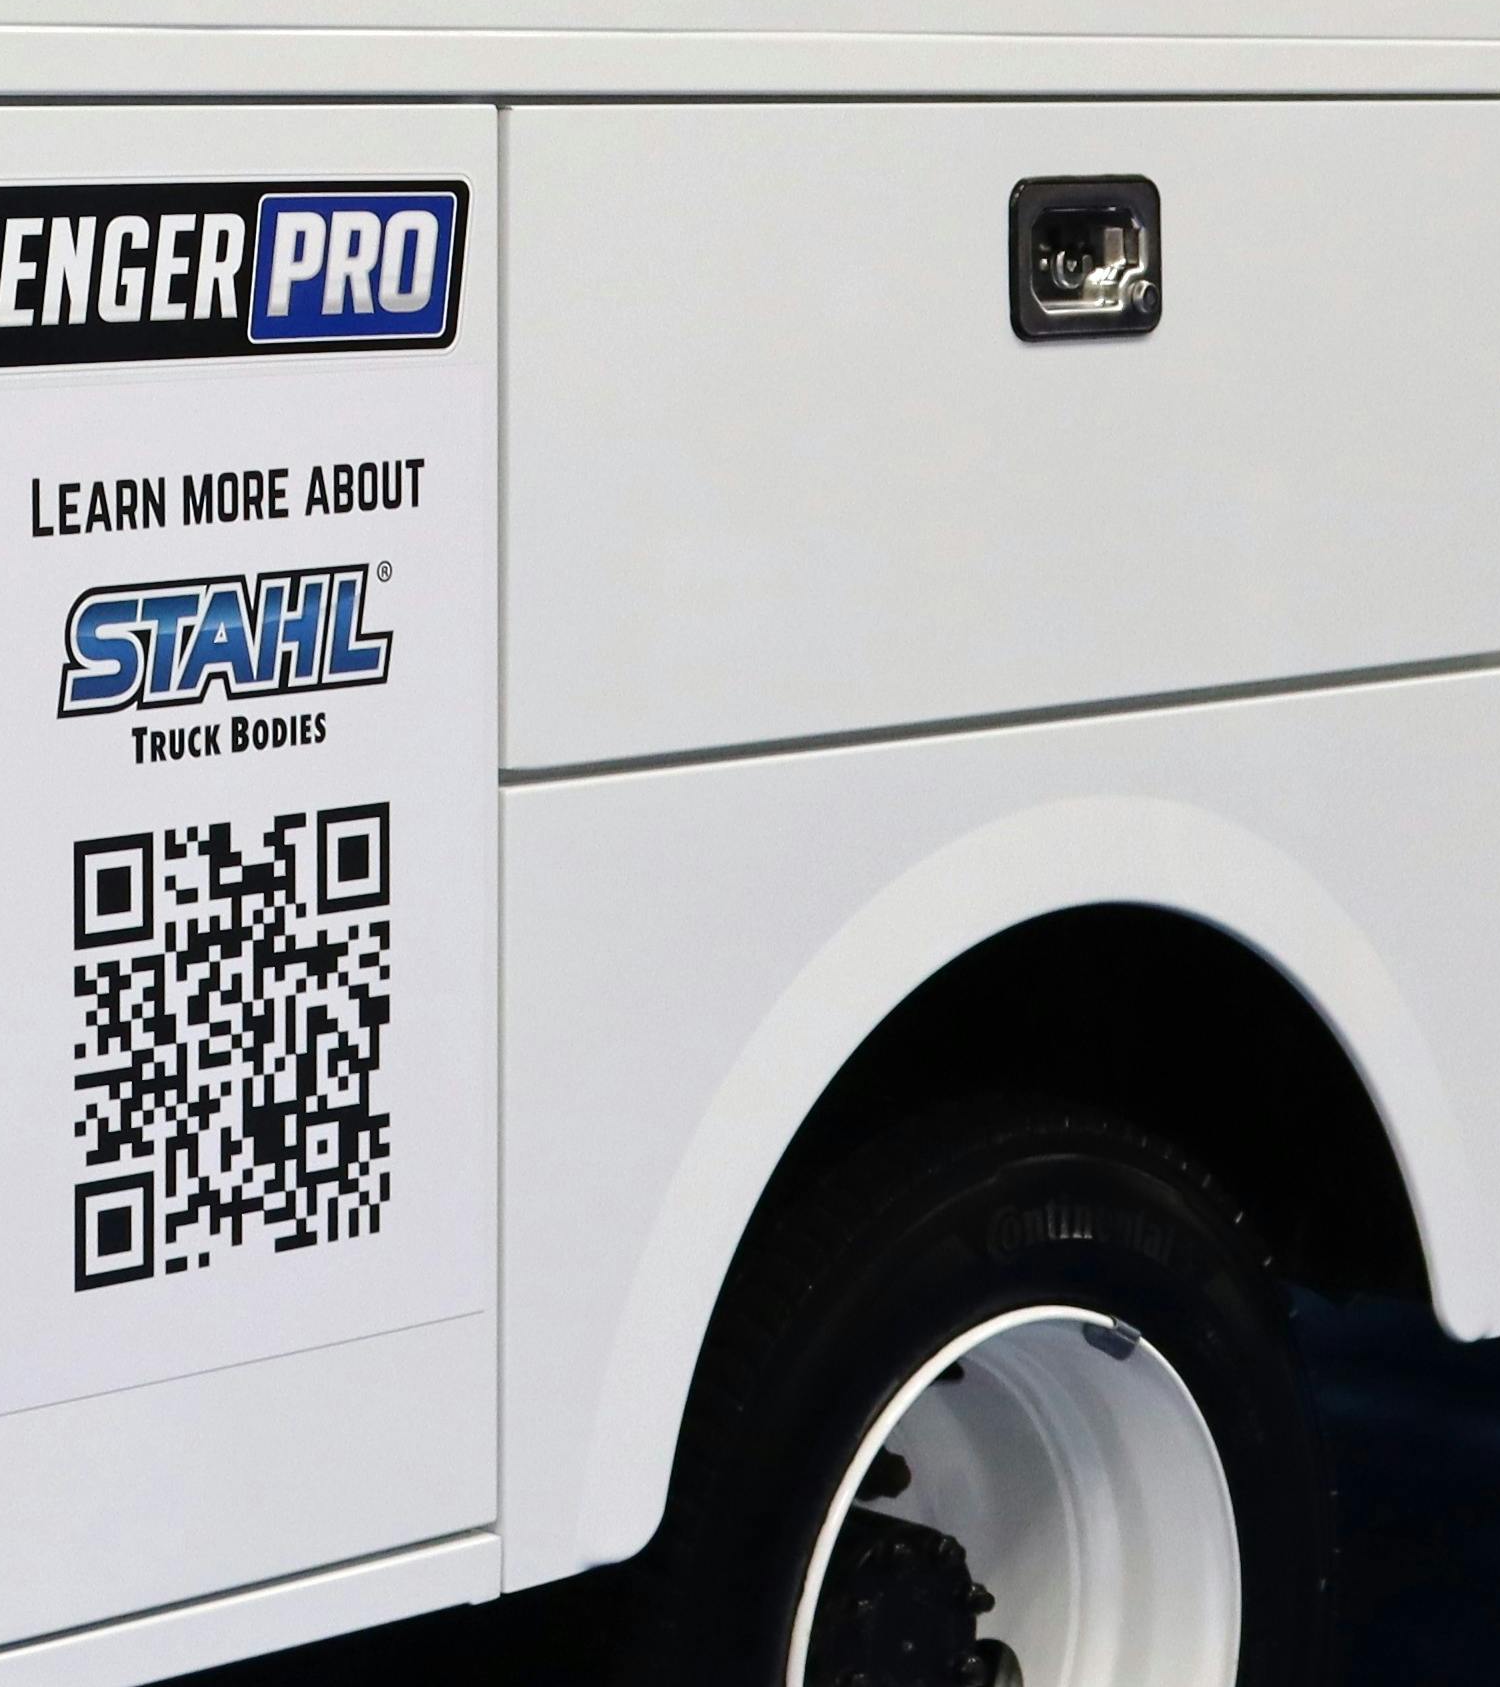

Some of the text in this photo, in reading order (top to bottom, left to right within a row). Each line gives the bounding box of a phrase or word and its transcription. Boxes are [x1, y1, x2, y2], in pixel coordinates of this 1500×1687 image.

[265, 209, 442, 318] PRO
[32, 457, 425, 538] LEARN MORE ABOUT
[57, 563, 395, 719] STAHL
[132, 712, 327, 765] TRUCK BODIES
